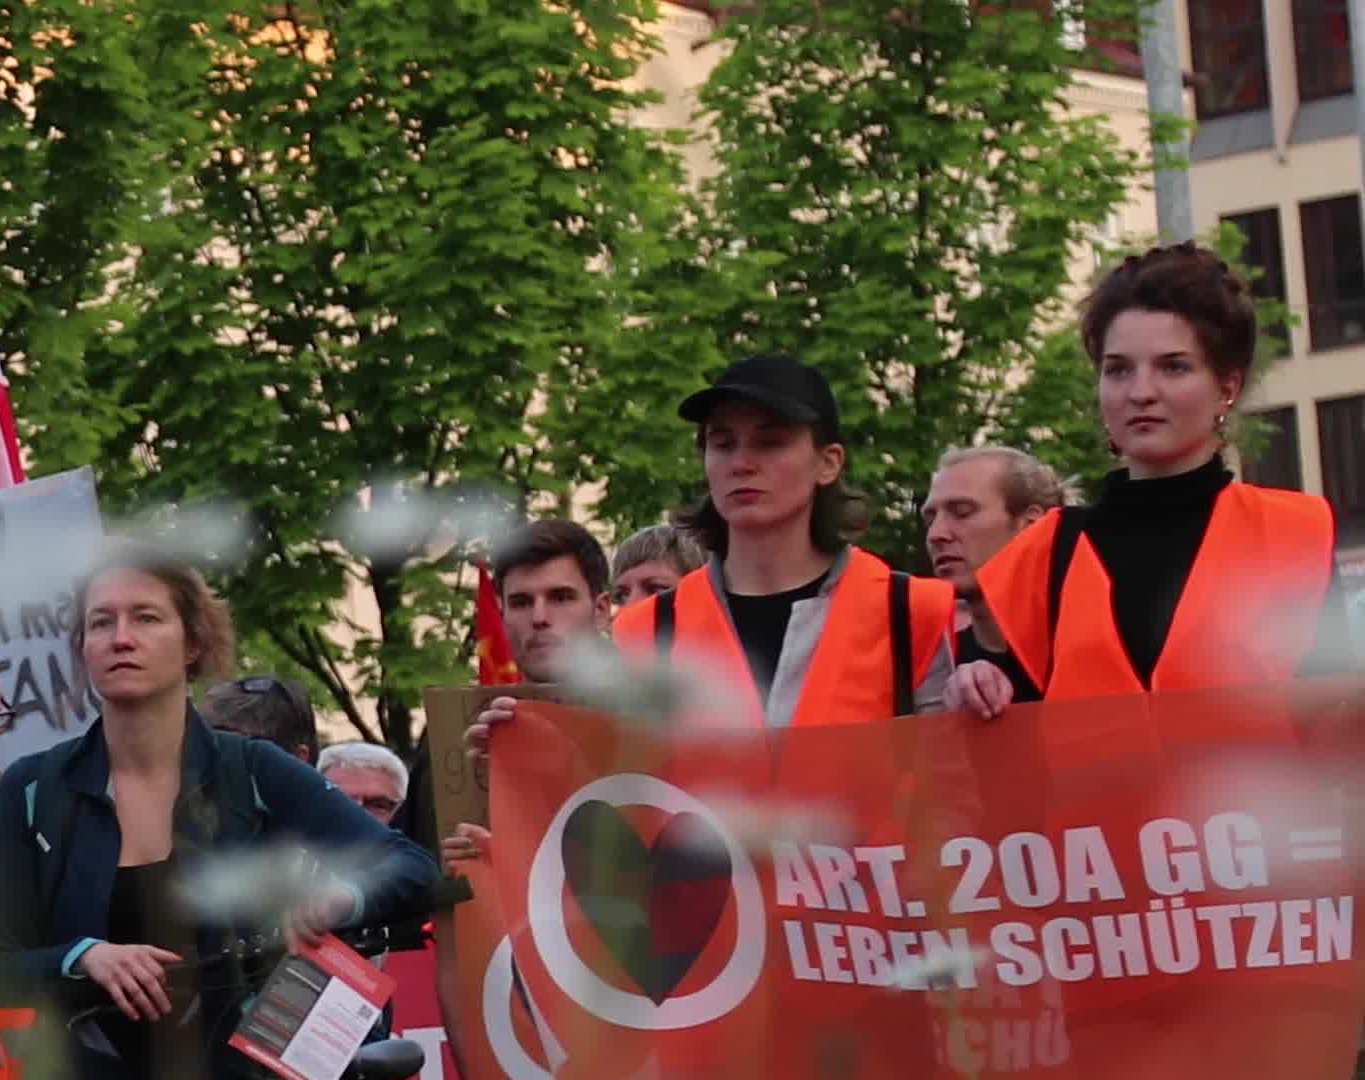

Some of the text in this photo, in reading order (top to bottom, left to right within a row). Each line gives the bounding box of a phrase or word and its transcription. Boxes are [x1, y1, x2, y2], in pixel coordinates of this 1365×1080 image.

[771, 842, 927, 918] ART.
[941, 826, 1126, 914] 20A
[1139, 812, 1269, 896] GG
[783, 896, 1354, 990] LEBEN SCHÜTZEN
